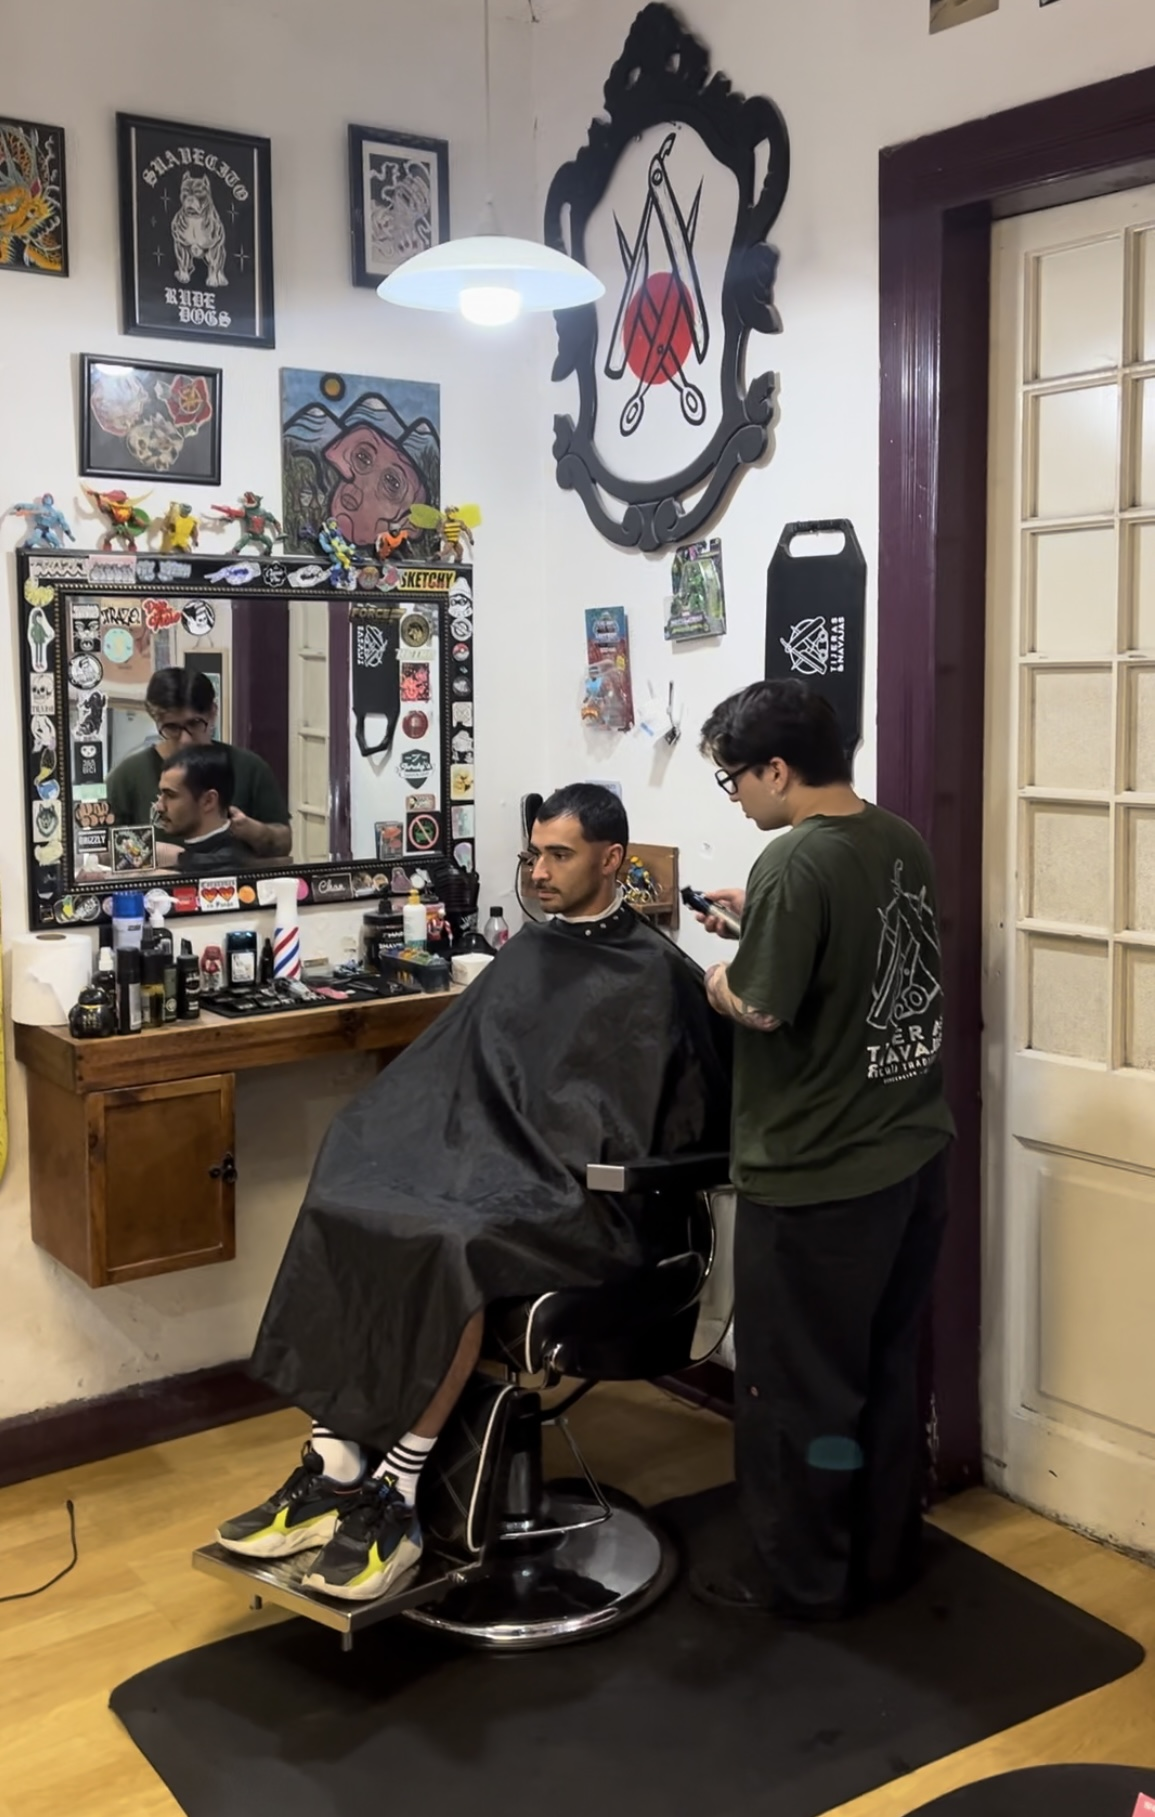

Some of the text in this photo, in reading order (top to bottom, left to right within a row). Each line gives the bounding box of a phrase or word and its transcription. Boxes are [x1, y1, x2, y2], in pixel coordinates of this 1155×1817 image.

[164, 286, 216, 310] RUDE
[178, 306, 232, 328] DOGS
[400, 571, 454, 589] SKETCHY
[830, 616, 838, 673] TIJERAS
